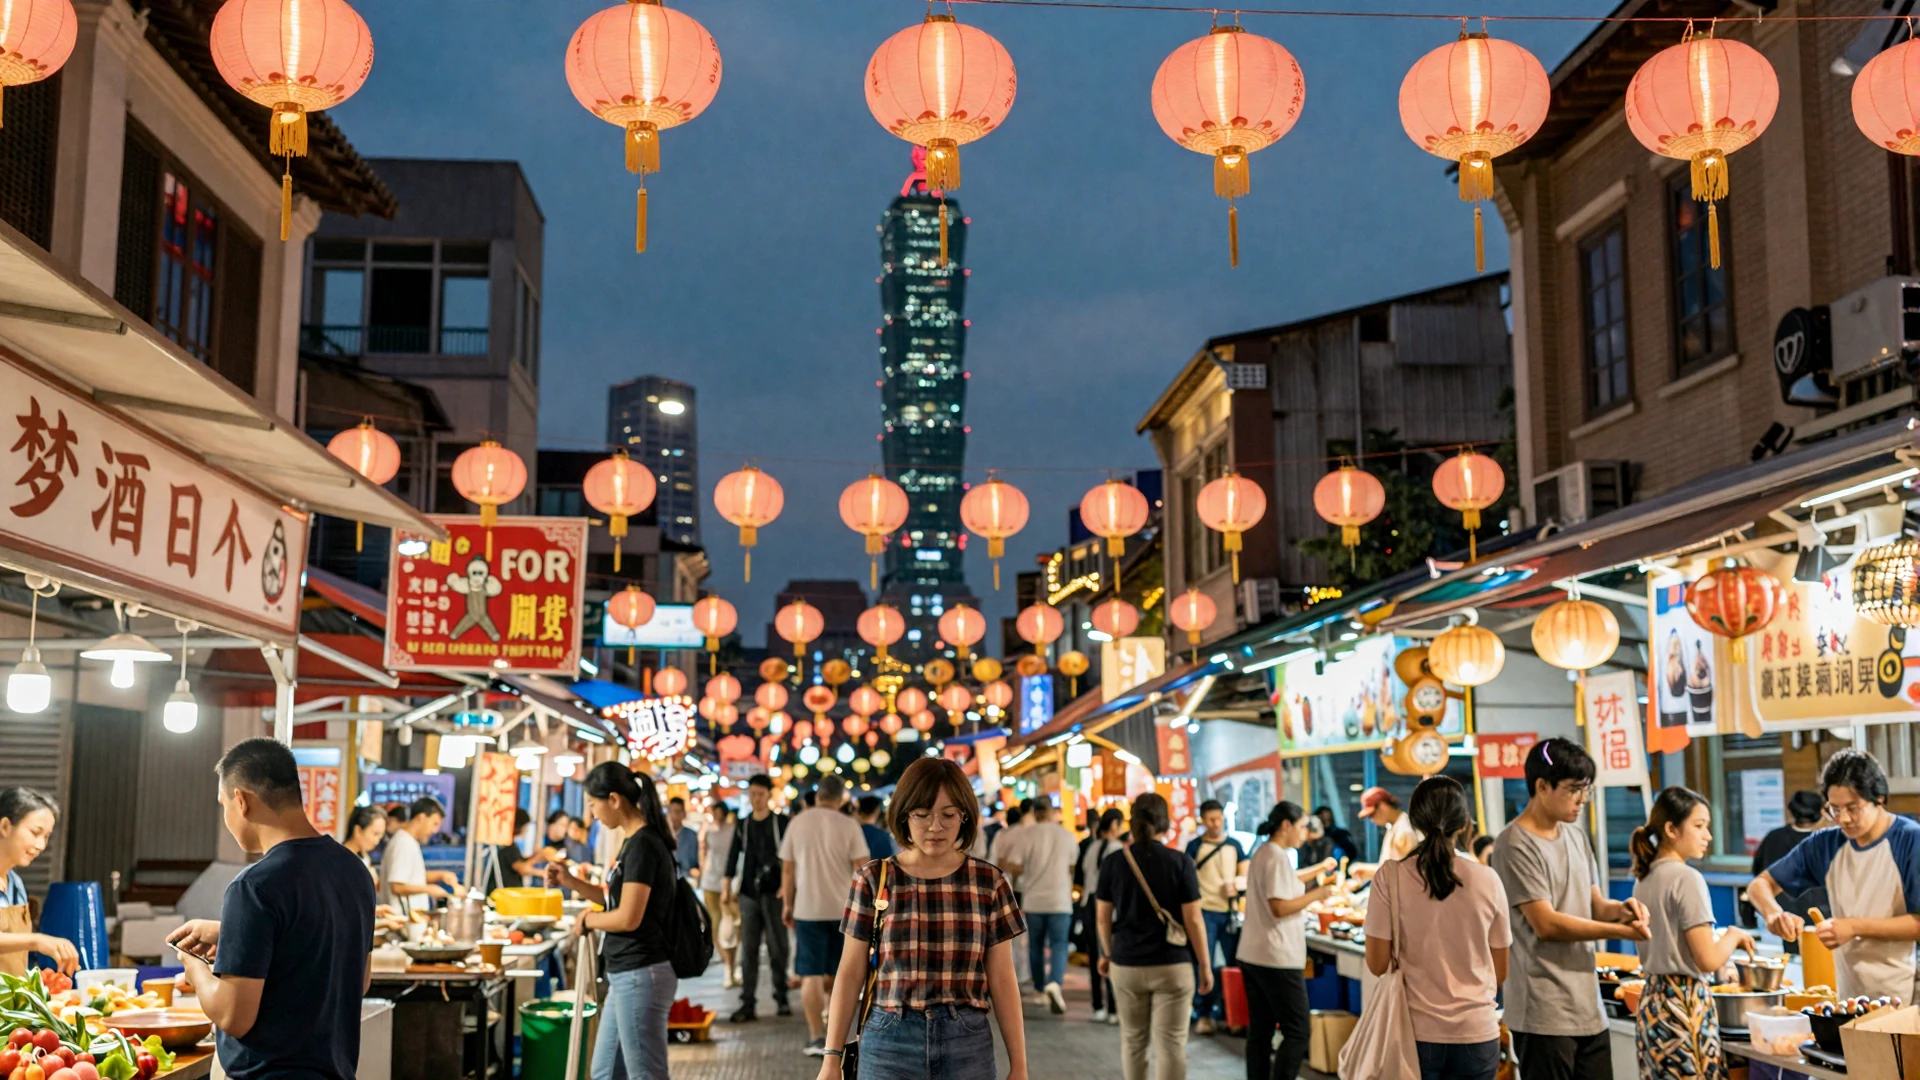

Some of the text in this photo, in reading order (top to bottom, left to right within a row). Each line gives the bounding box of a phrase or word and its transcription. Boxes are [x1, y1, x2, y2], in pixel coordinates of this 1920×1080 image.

[9, 395, 253, 593] 梦酒日个
[501, 548, 570, 583] FOR
